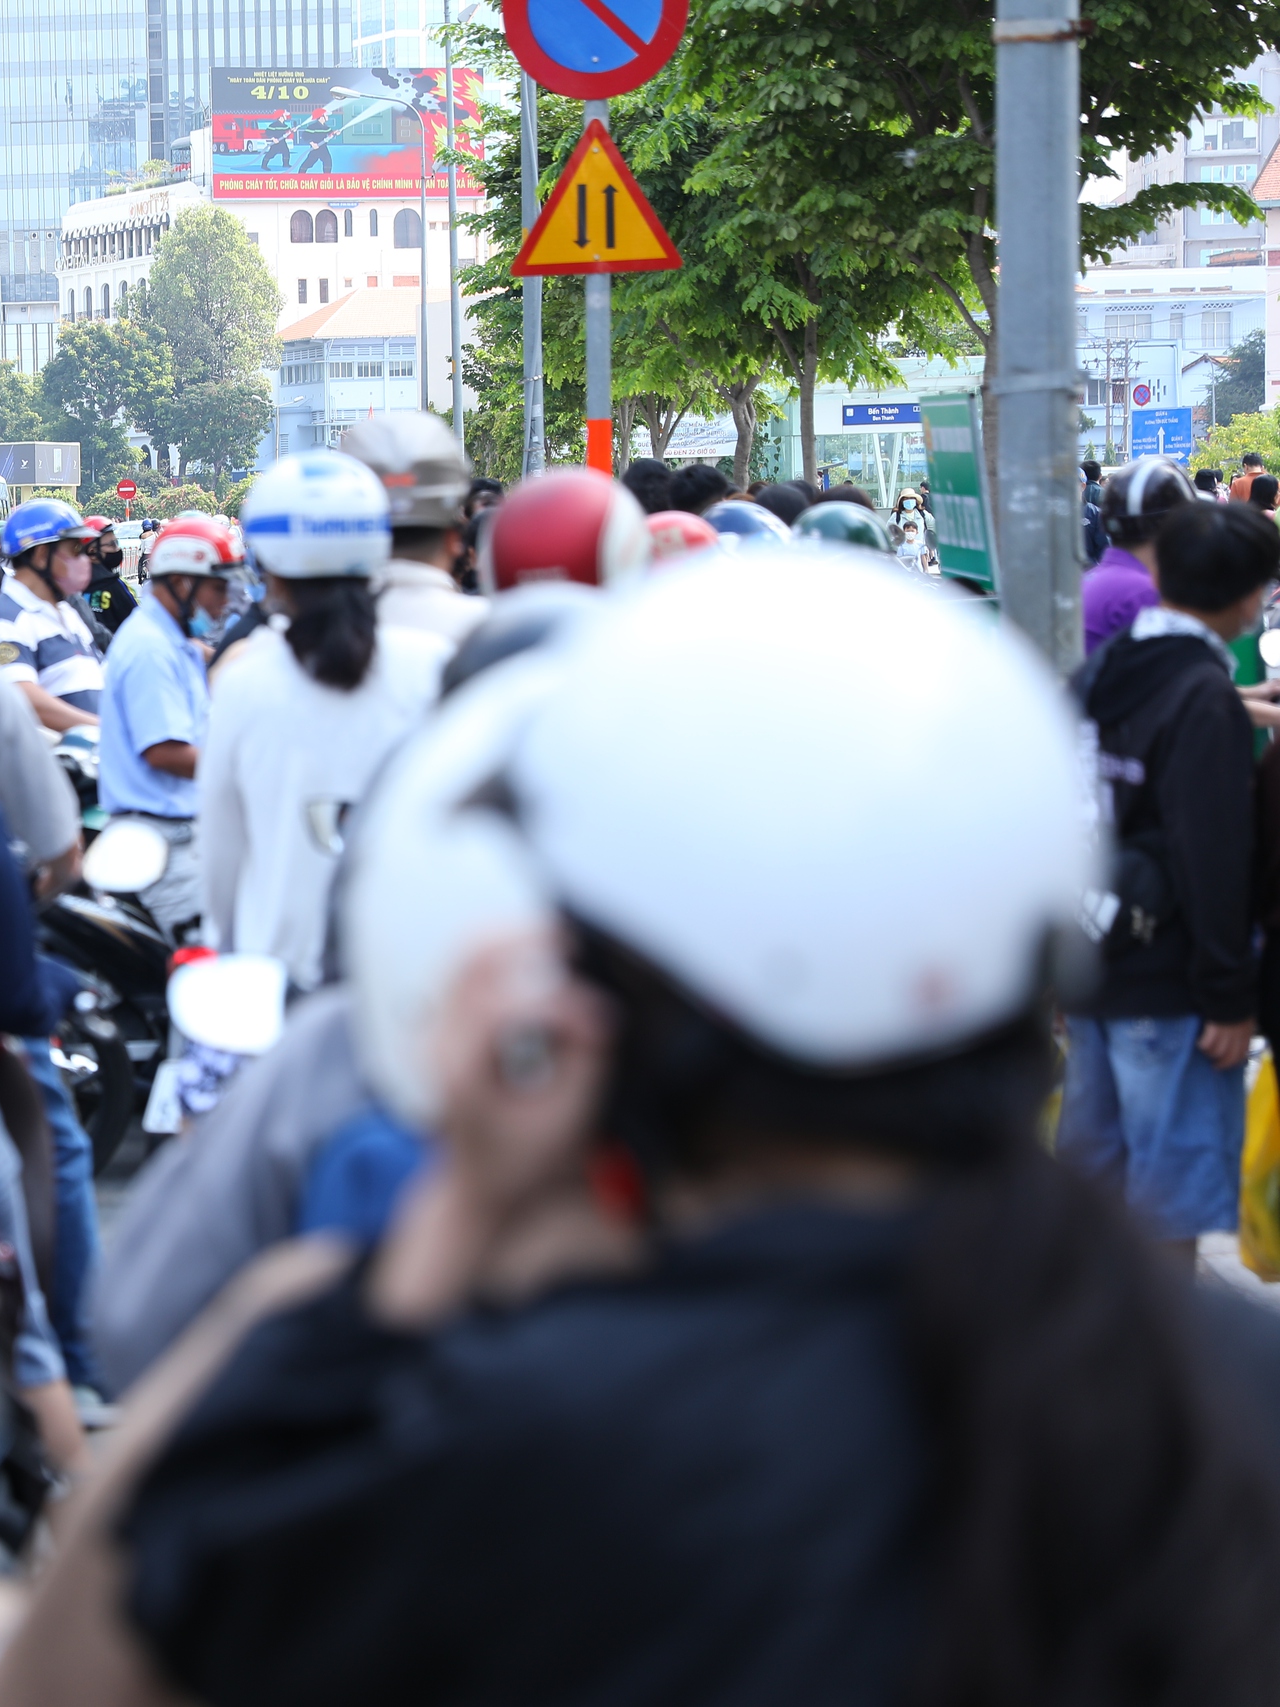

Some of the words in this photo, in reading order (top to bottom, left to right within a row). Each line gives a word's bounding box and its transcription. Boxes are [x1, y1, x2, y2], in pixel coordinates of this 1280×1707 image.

[250, 85, 309, 100] 4/10
[219, 178, 244, 191] PHÒNG
[245, 178, 263, 190] CHÁY
[265, 176, 279, 191] TỐT,
[280, 177, 299, 190] CHỮA
[300, 178, 318, 190] CHÁY
[320, 176, 334, 190] GIỎI
[335, 177, 345, 190] LÀ
[346, 176, 360, 190] BẢO
[361, 177, 370, 191] VỆ
[372, 177, 393, 190] CHÍNH
[395, 177, 413, 190] MÌNH
[867, 407, 880, 415] Bến
[880, 406, 899, 415] Thành
